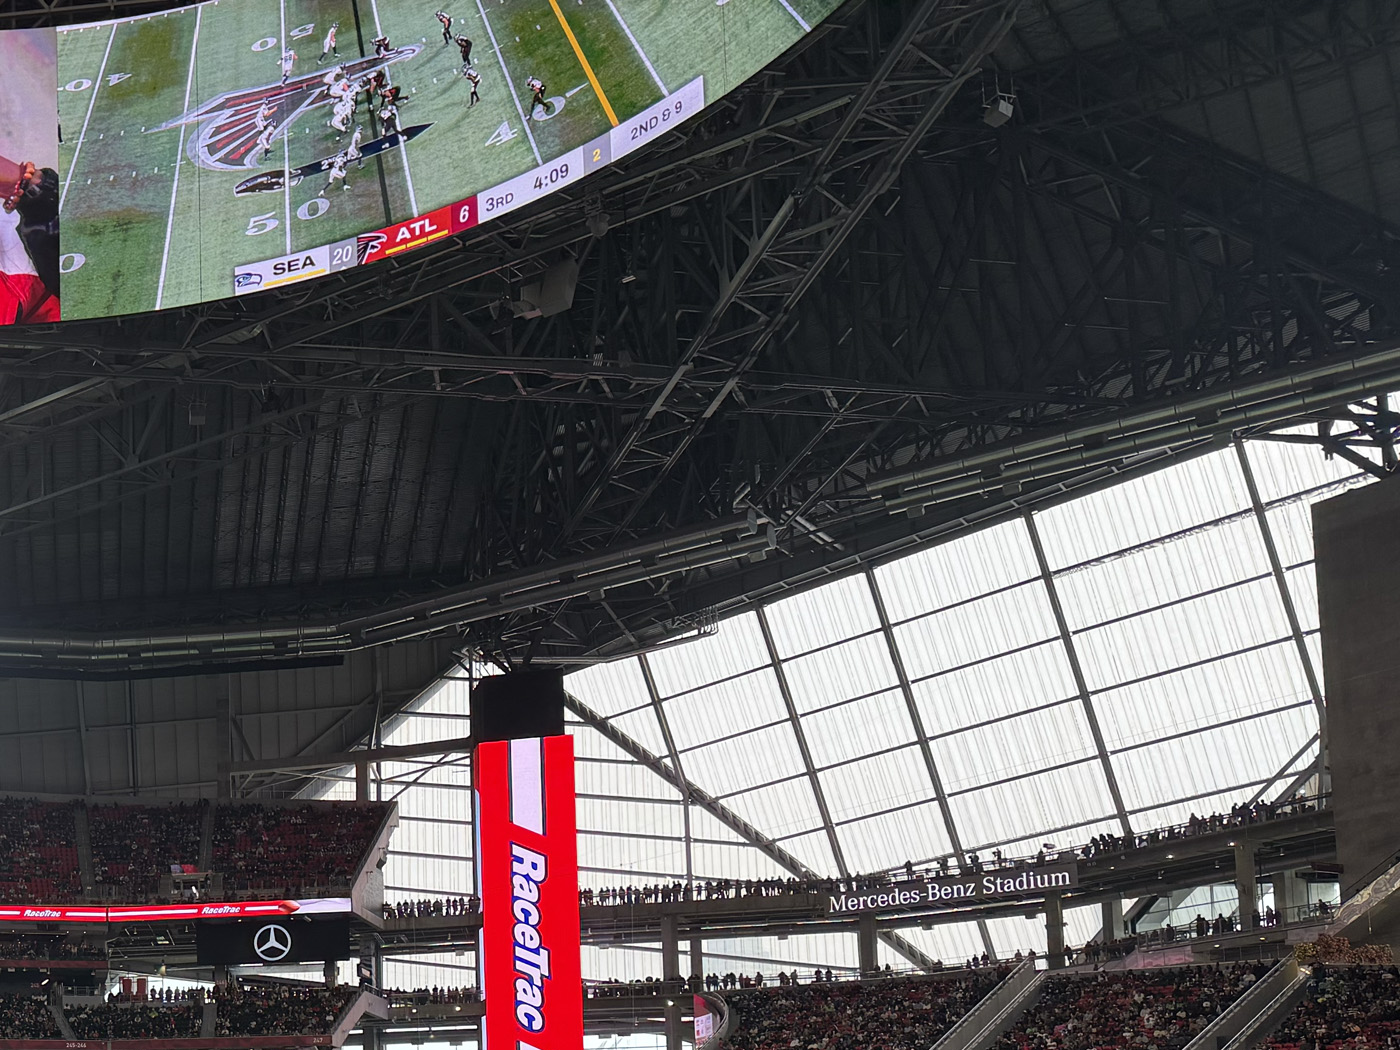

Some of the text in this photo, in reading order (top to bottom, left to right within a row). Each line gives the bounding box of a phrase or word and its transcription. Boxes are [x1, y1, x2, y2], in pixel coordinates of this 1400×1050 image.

[630, 101, 683, 141] 2ND & 9
[592, 149, 601, 162] 2
[485, 164, 569, 212] 3RD 4:09
[459, 206, 470, 223] 6
[395, 220, 438, 243] ATL
[272, 256, 316, 276] SEA
[332, 245, 352, 266] 20
[829, 871, 1071, 914] Mercedes-Benz Stadium
[23, 908, 61, 918] RaceTrac
[201, 905, 241, 915] RaceTrac
[510, 841, 552, 1034] RaceTrac
